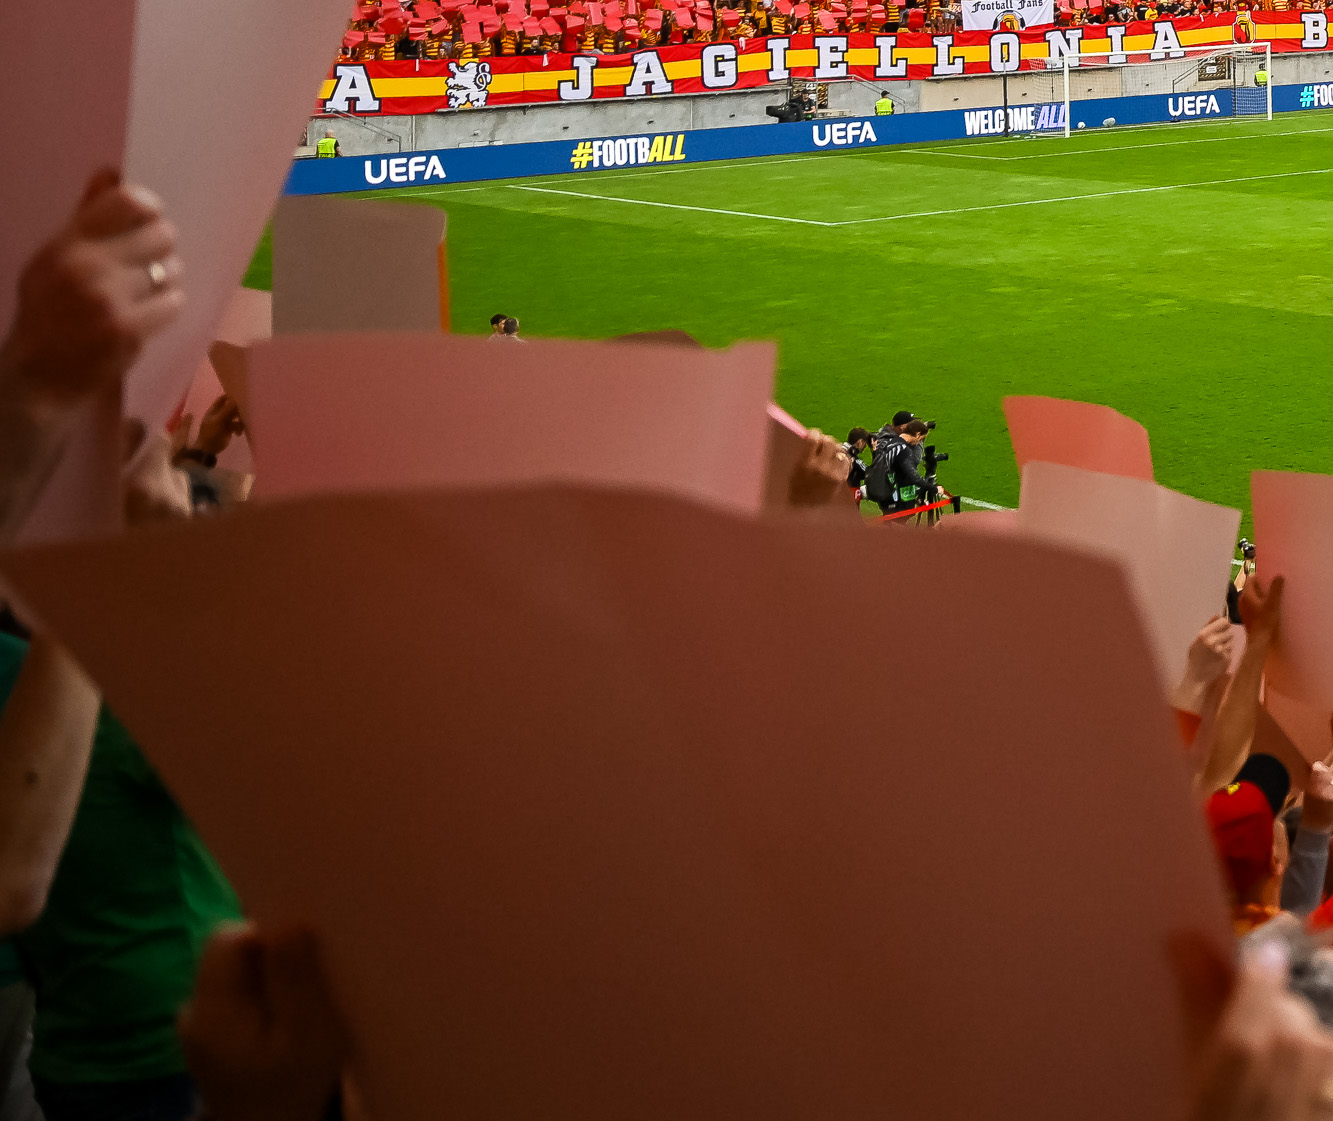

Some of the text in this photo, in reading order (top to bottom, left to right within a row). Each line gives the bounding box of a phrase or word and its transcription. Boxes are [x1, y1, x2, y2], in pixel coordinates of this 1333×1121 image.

[971, 0, 1014, 14] Football
[558, 21, 1186, 101] JAGIELLONIA
[964, 102, 1066, 137] WELCOME ALL
[1168, 93, 1220, 119] UEFA
[812, 120, 877, 147] UEFA
[571, 134, 686, 170] #FOOTBALL
[365, 156, 446, 184] UEFA
